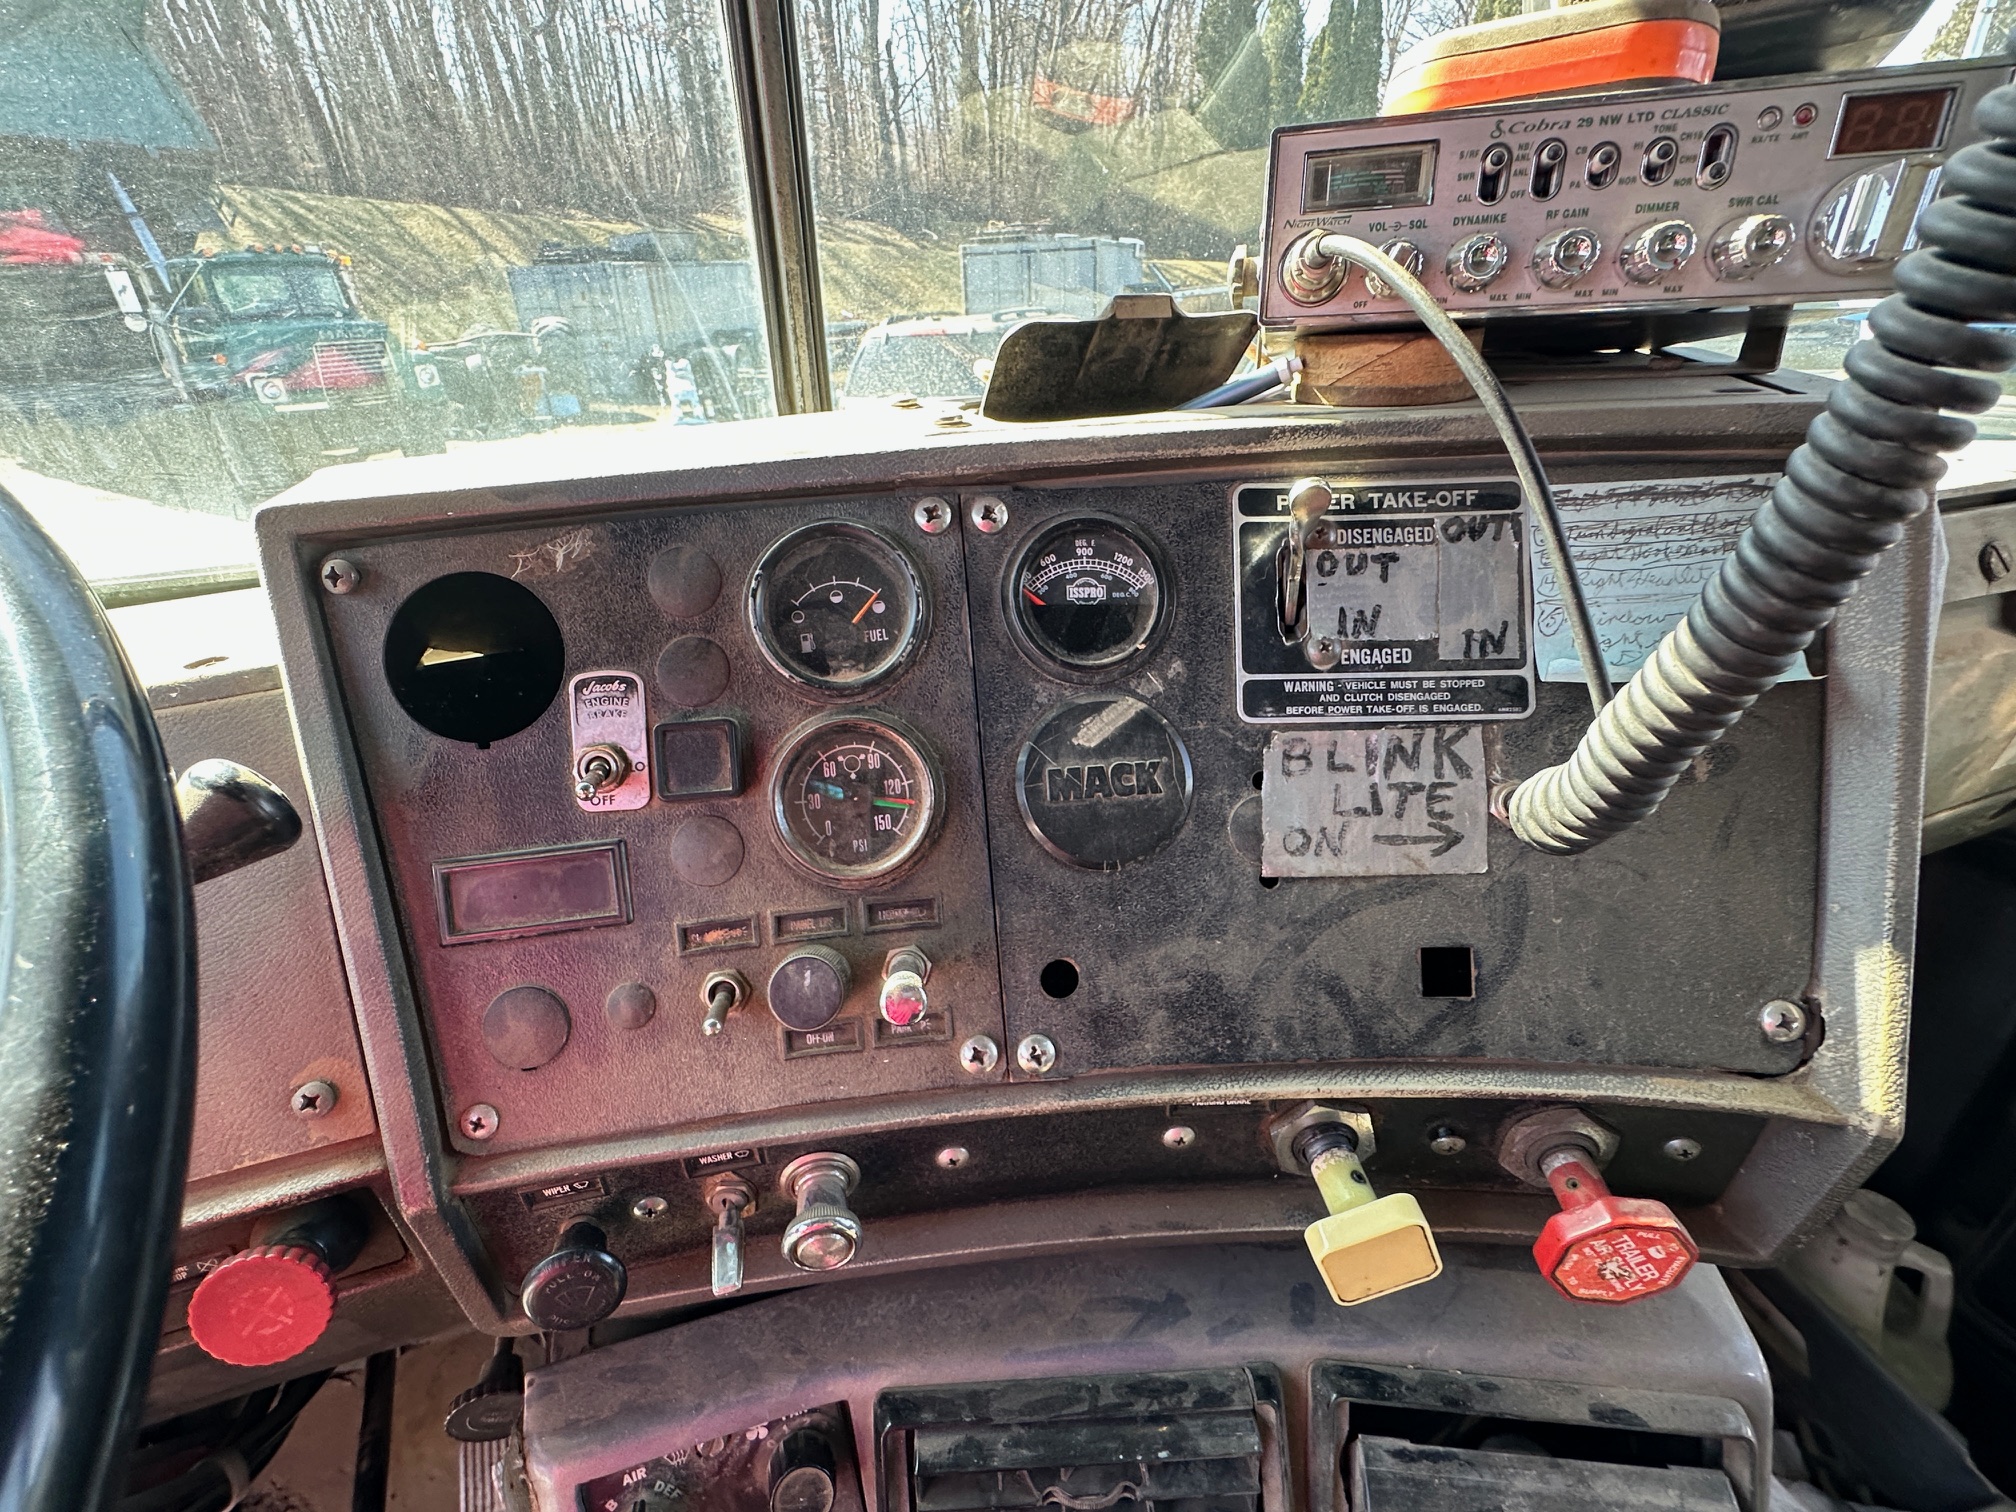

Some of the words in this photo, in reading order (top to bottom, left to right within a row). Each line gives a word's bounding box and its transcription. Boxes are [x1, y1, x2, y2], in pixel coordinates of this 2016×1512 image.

[1508, 118, 1572, 134] Cobra
[1577, 117, 1594, 128] 29
[1599, 113, 1623, 127] NW
[1627, 111, 1655, 124] LTD
[1661, 103, 1730, 120] CLASSIC
[1653, 123, 1678, 134] TONE
[1459, 149, 1480, 160] S/RF
[1514, 152, 1531, 162] ANL
[1575, 146, 1588, 156] CB
[1457, 172, 1476, 182] SWR
[1512, 168, 1529, 178] ANL
[1569, 181, 1581, 190] PA
[1673, 177, 1692, 187] NOR
[1457, 193, 1473, 203] CAL
[1510, 189, 1527, 199] OFF
[1728, 196, 1754, 208] SWR
[1756, 194, 1780, 206] CAL
[1546, 209, 1560, 221] RF
[1562, 207, 1590, 219] GAIN
[1634, 201, 1680, 214] DIMMER
[1368, 221, 1388, 232] VOL
[1408, 218, 1428, 230] SQL
[1452, 213, 1508, 227] DYNAMIKE
[1574, 289, 1594, 298] MAX
[1602, 288, 1618, 296] MIN
[1663, 285, 1685, 294] MAX
[1353, 301, 1368, 309] OFF
[1276, 492, 1356, 512] PER
[1368, 490, 1479, 509] TAKE-OFF
[1337, 526, 1434, 545] DISENGAGED
[1440, 514, 1511, 543] OUT
[1076, 547, 1093, 556] 900
[1040, 554, 1057, 567] 600
[1113, 552, 1134, 566] 1200
[1316, 551, 1399, 583] OUT
[1137, 567, 1155, 585] 1500
[1069, 587, 1104, 599] ISSPRO
[1337, 604, 1382, 638] IN
[864, 628, 889, 643] FUEL
[1462, 621, 1508, 658] IN
[1341, 648, 1412, 665] ENGAGED
[582, 680, 627, 696] Jacobs
[1284, 681, 1334, 692] WARNING
[1345, 681, 1386, 690] VEHICLE
[1390, 680, 1419, 689] MUST
[1423, 680, 1436, 689] BE
[1440, 679, 1485, 689] STOPPED
[584, 697, 630, 709] ENGINE
[1319, 693, 1340, 702] AND
[1344, 693, 1383, 702] CLUTCH
[1388, 692, 1451, 702] DISENGAGED
[587, 708, 628, 720] BRAKE
[1286, 706, 1324, 715] BEFORE
[1328, 705, 1362, 715] POWER
[1366, 704, 1415, 714] TAKE-OFF
[1418, 704, 1429, 713] IS
[1433, 703, 1484, 713] ENGAGED.
[868, 753, 881, 769] 90
[1282, 727, 1474, 782] BLINK
[823, 761, 837, 778] 60
[884, 779, 901, 795] 120
[1045, 759, 1164, 802] MACK
[590, 795, 616, 806] OFF
[808, 793, 821, 810] 30
[1333, 781, 1458, 819] LITE
[825, 820, 832, 836] 0
[874, 814, 892, 831] 150
[853, 839, 868, 853] PSI
[1283, 821, 1348, 857] ON
[699, 1151, 734, 1165] WASHER
[542, 1183, 570, 1198] WIPER
[1636, 1231, 1661, 1240] PULL
[1589, 1239, 1614, 1256] AIR
[1612, 1234, 1660, 1282] TRAILER
[622, 1466, 648, 1487] AIR
[654, 1480, 682, 1499] DEF
